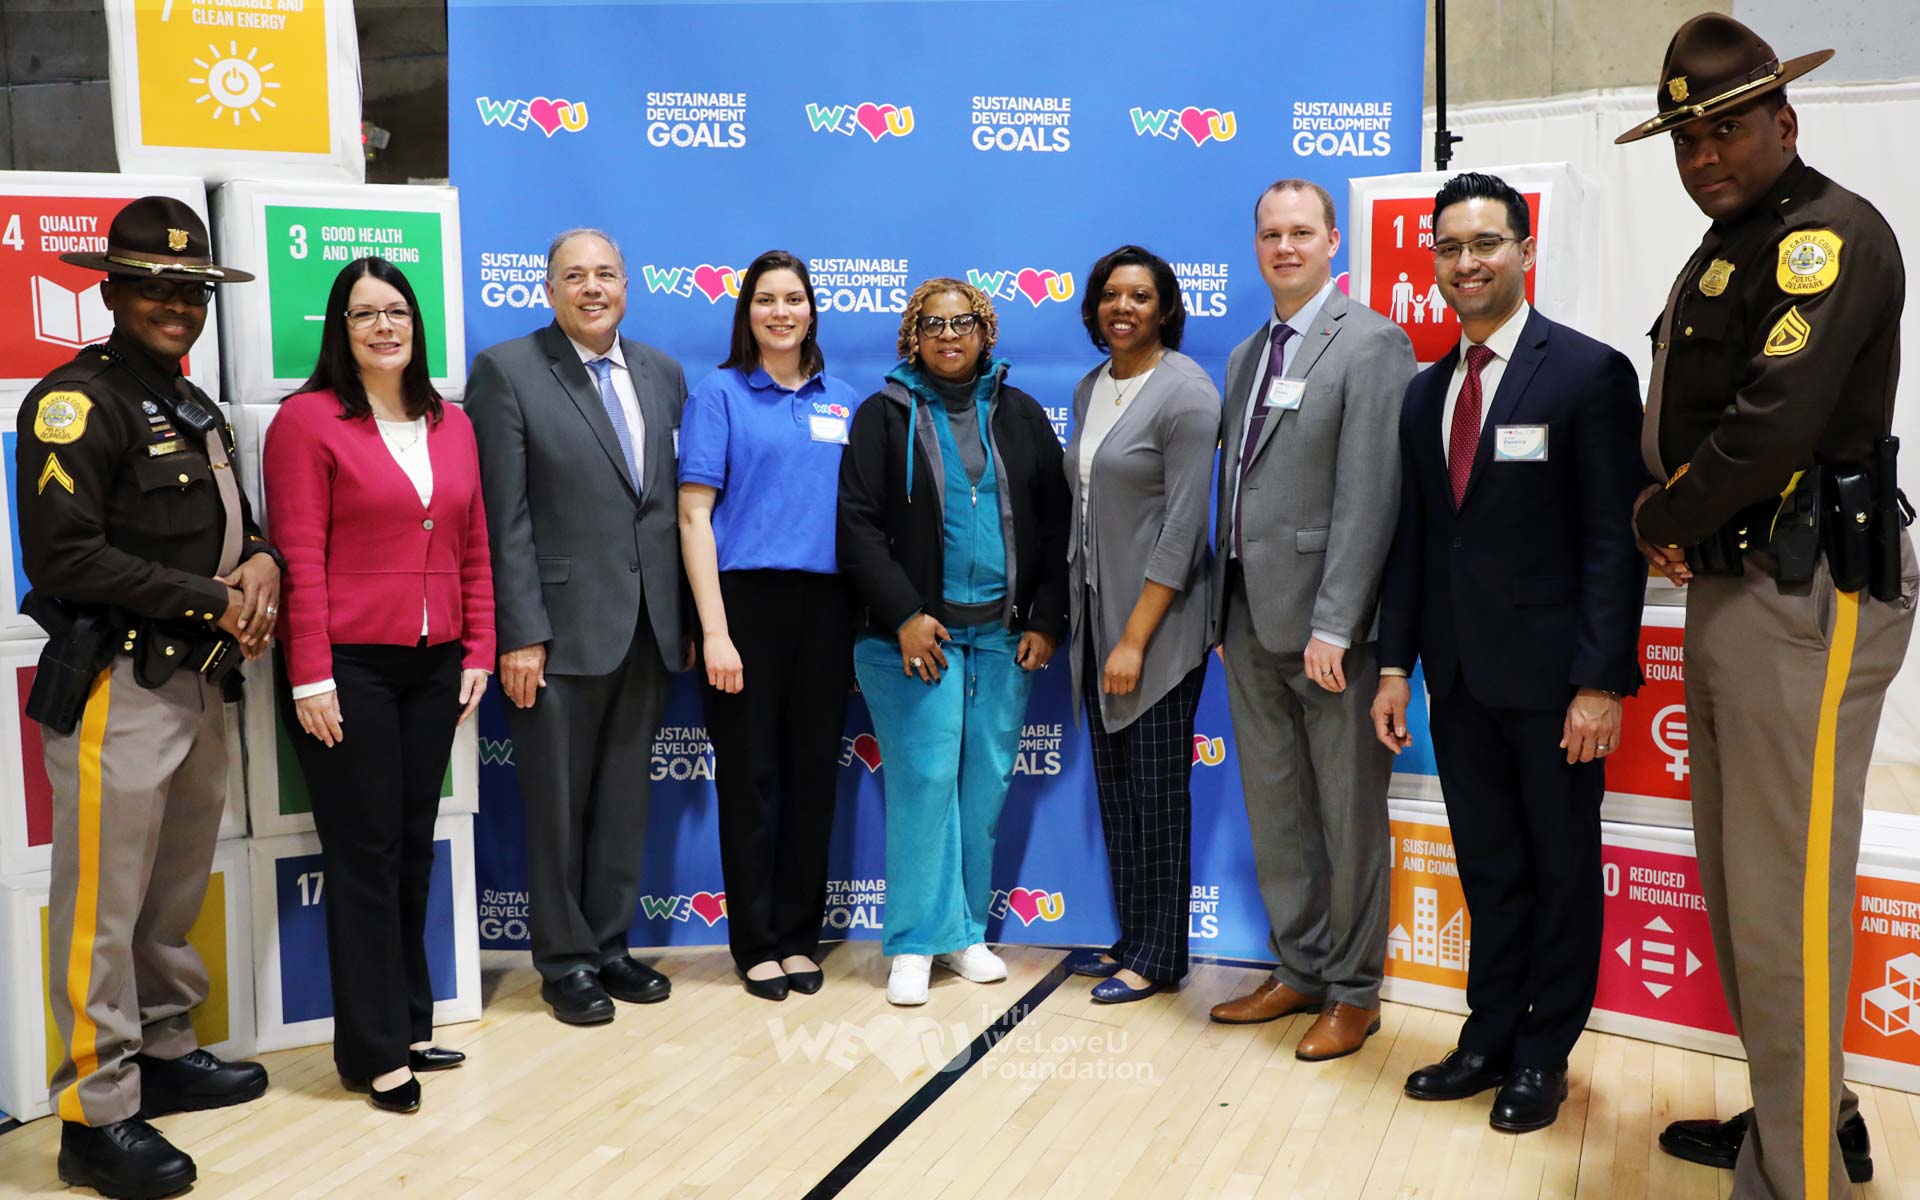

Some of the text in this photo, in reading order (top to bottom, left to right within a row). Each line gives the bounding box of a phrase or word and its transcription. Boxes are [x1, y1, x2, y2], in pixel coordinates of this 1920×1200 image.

[192, 8, 286, 30] CLEAN ENERGY
[646, 92, 747, 107] SUSTAINABLE
[972, 96, 1071, 111] SUSTAINABLE
[646, 108, 747, 122] DEVELOPMENT
[1293, 102, 1392, 116] SUSTAINABLE
[972, 112, 1071, 126] DEVELOPMENT
[1292, 117, 1392, 131] DEVELOPMENT
[647, 121, 747, 148] GOALS
[972, 125, 1071, 152] GOALS
[1292, 131, 1391, 156] GOALS
[2, 214, 25, 251] 4
[39, 215, 98, 233] QUALITY
[1393, 215, 1405, 249] 1
[289, 224, 309, 259] 3
[321, 226, 403, 244] GOOD HEALTH
[1790, 235, 1817, 249] CASTLE
[322, 245, 420, 263] AND WELL-BEING
[481, 252, 549, 268] SUSTAIN
[809, 258, 908, 273] SUSTAINABLE
[481, 268, 548, 282] DEVELOP
[809, 274, 908, 287] DEVELOPMENT
[1791, 274, 1819, 283] POLICE
[1785, 280, 1825, 290] DELAWARE
[813, 287, 908, 313] GOALS
[1402, 856, 1425, 872] AND
[1629, 866, 1686, 889] REDUCED
[297, 871, 324, 907] 17
[1860, 915, 1889, 935] AND
